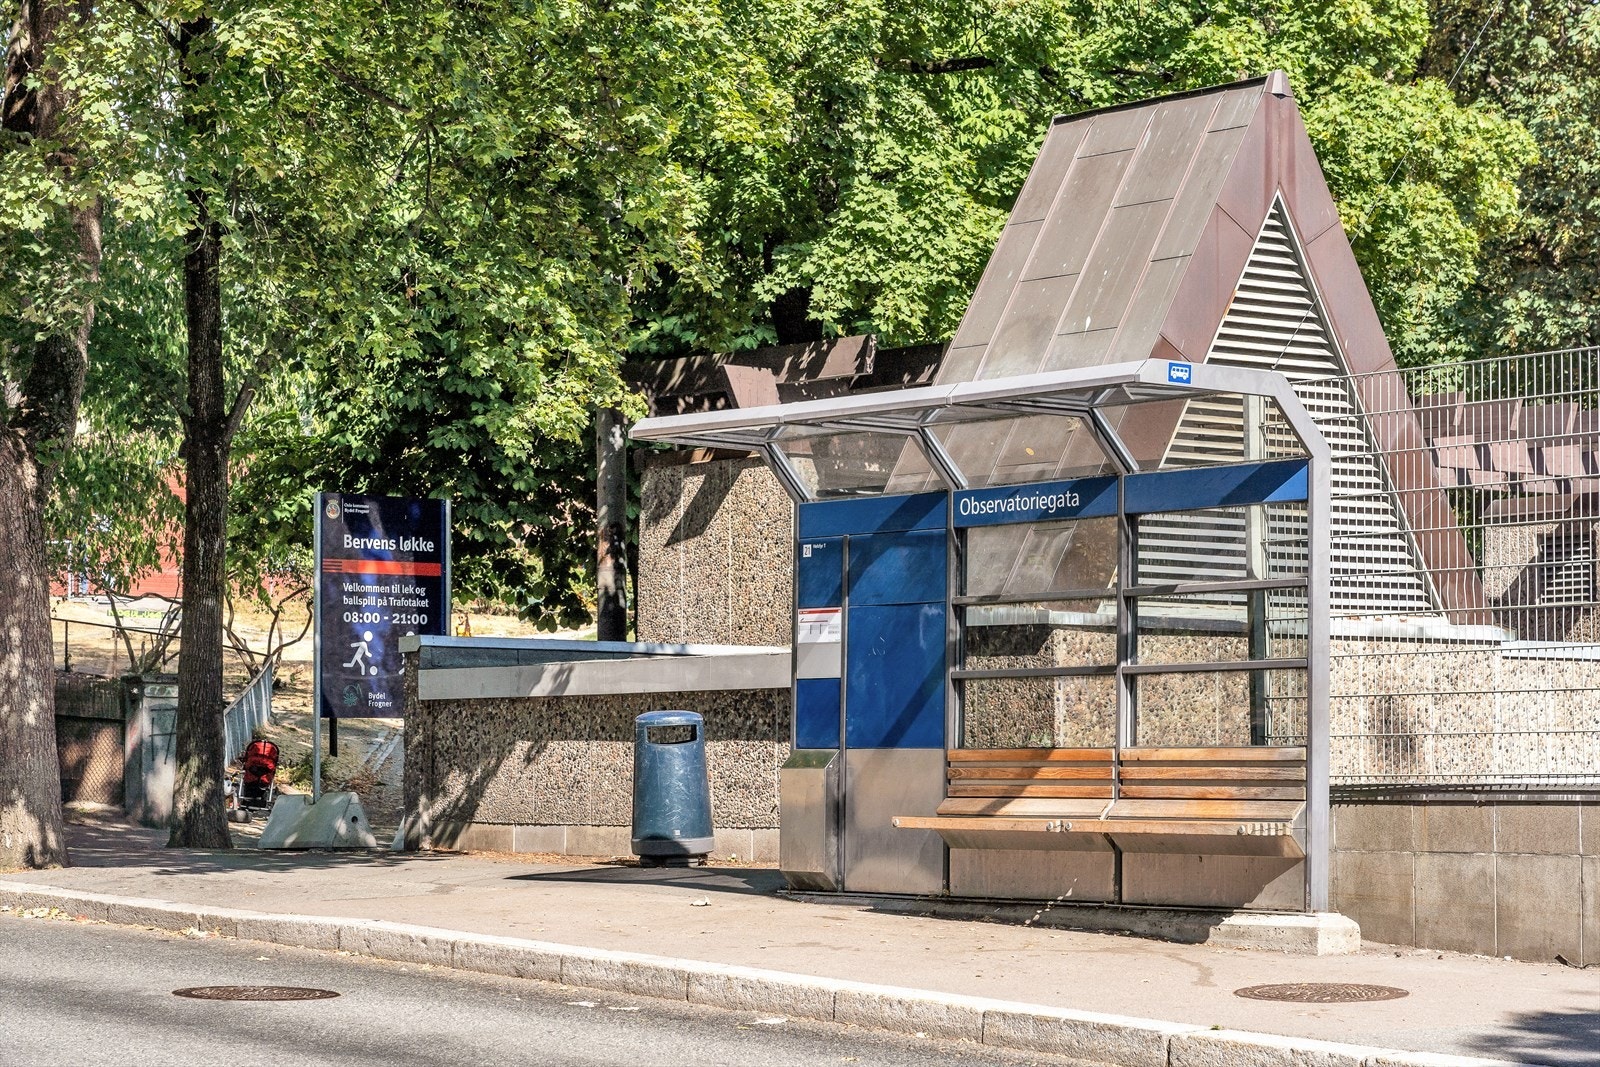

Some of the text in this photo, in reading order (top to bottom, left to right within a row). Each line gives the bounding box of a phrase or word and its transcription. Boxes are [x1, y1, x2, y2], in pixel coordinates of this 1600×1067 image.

[959, 490, 1080, 516] Observatoriegata
[343, 534, 435, 553] Bervens løkke
[342, 582, 427, 597] Velkommen til lek og
[343, 595, 430, 608] ballspill på Trafotaket
[343, 611, 381, 624] 08:00
[391, 612, 428, 625] 21:00
[368, 692, 386, 700] Bydel
[368, 700, 393, 709] Frogner
